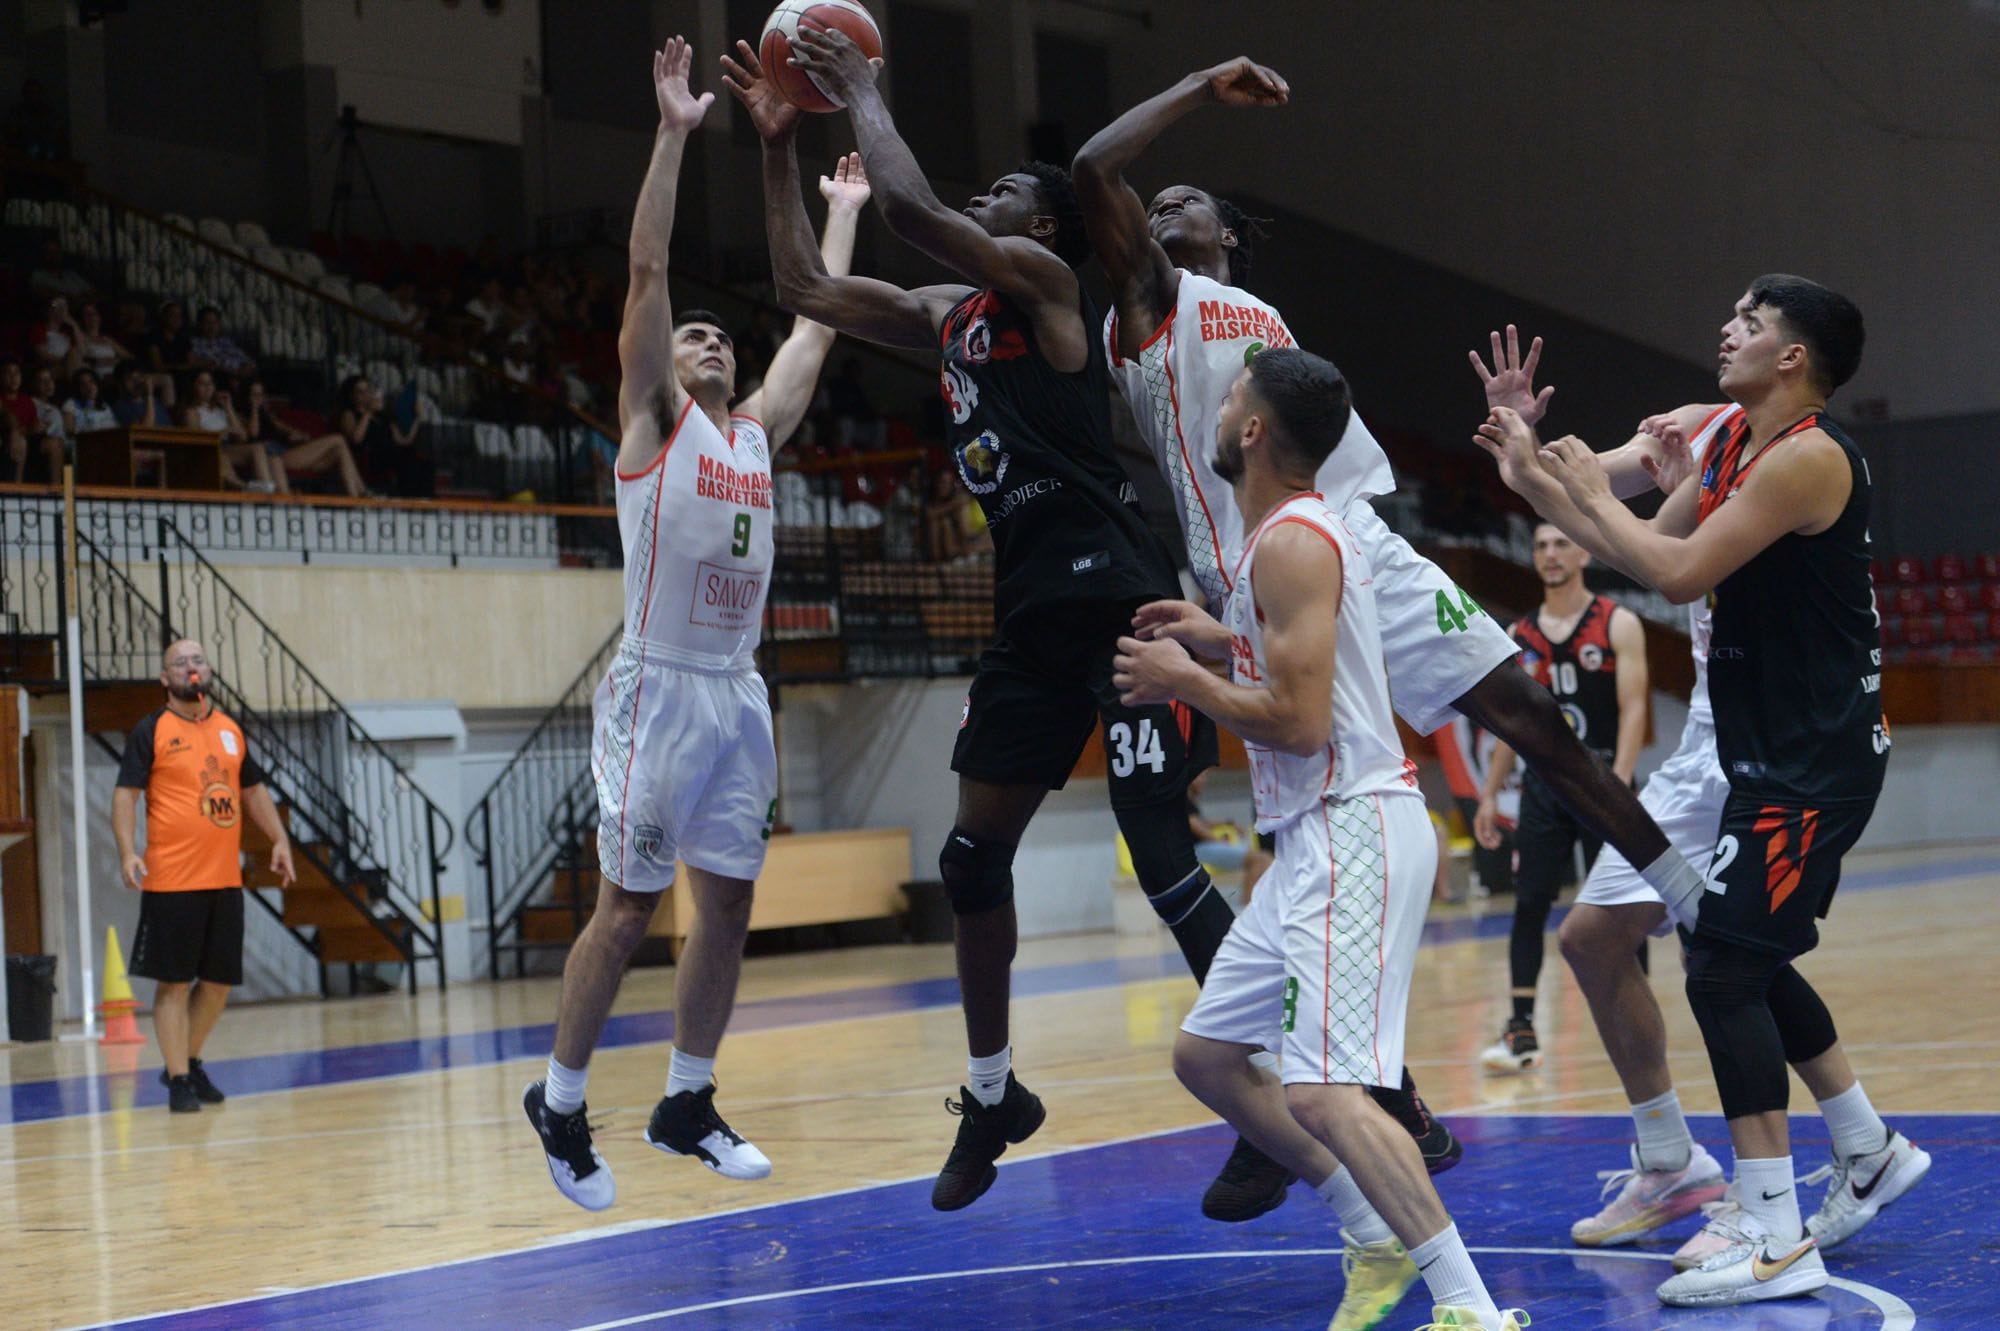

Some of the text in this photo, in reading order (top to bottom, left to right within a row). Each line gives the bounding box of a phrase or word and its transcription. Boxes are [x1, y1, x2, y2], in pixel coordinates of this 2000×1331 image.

[1201, 321, 1287, 349] BASKETB
[942, 360, 979, 424] 34
[697, 475, 771, 510] BASKETBAL
[732, 513, 751, 558] 9
[1073, 558, 1092, 571] LGB
[1435, 583, 1487, 635] 44
[1549, 662, 1578, 696] 10
[1110, 718, 1166, 778] 34
[1705, 834, 1739, 896] 2
